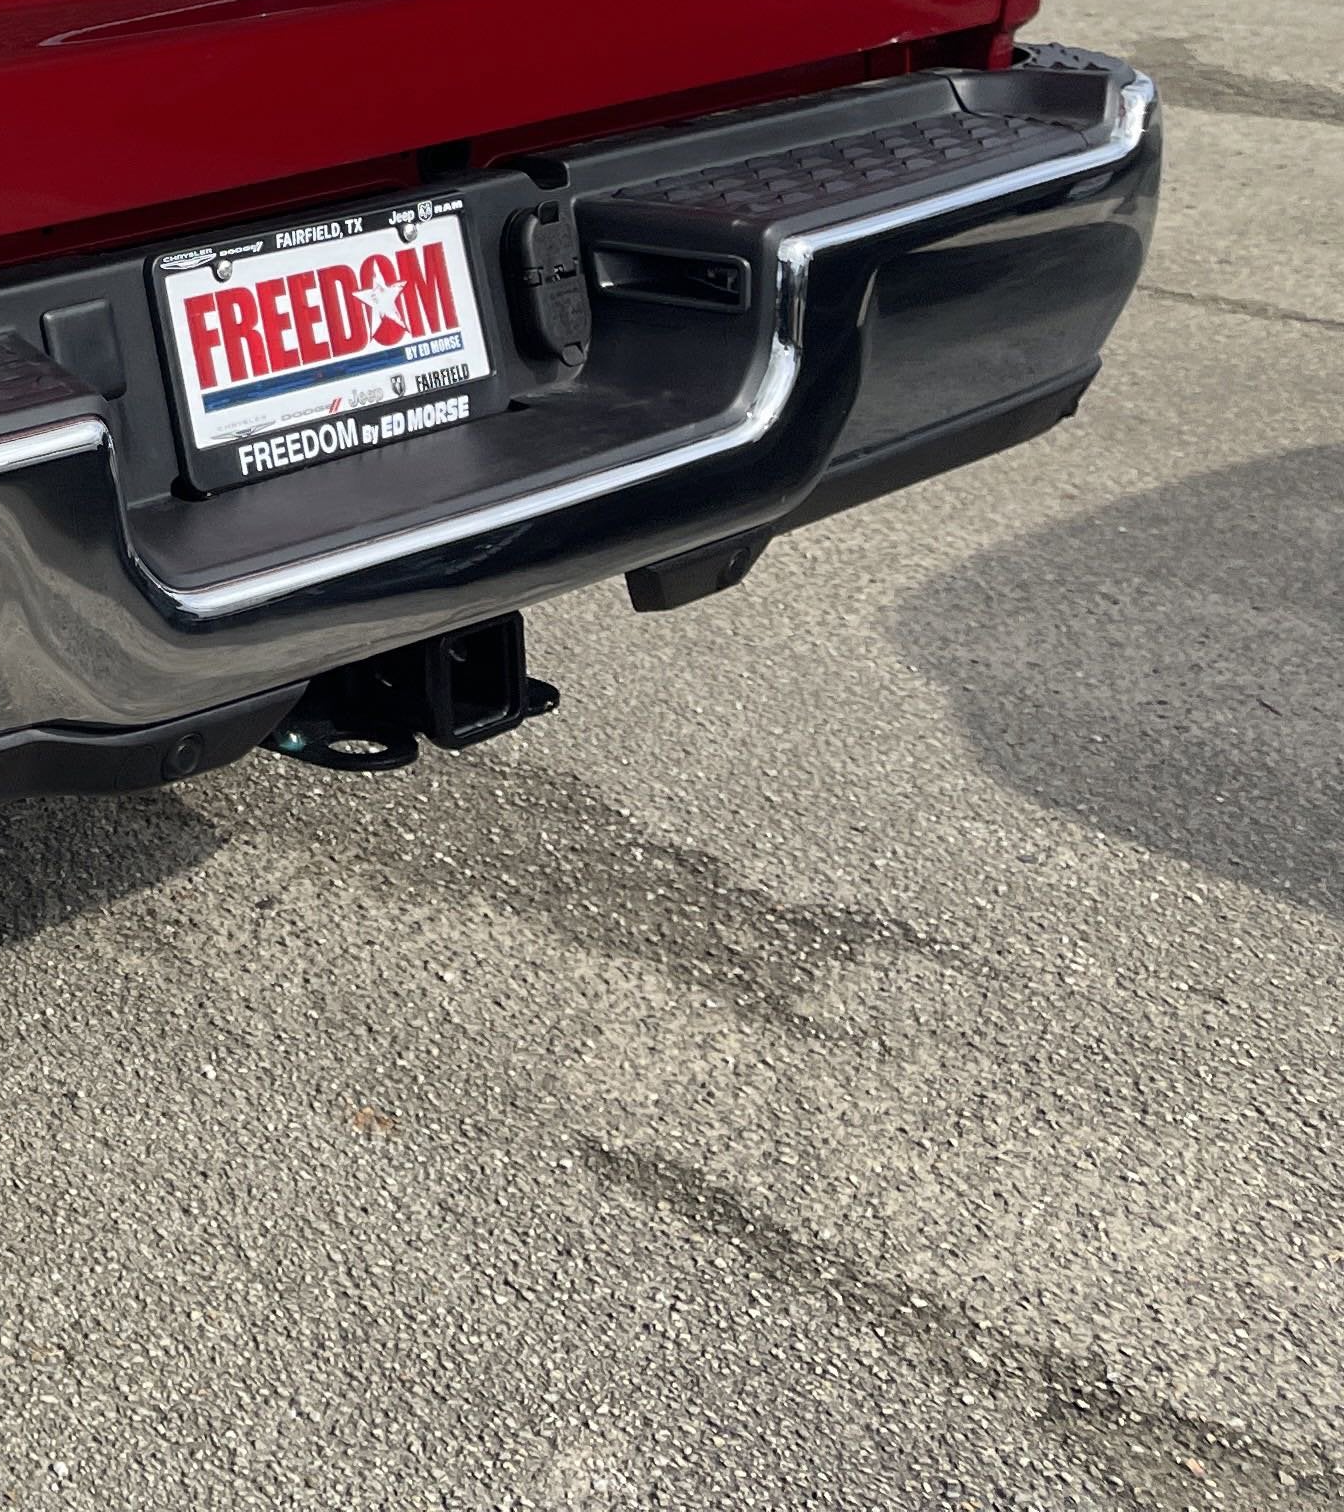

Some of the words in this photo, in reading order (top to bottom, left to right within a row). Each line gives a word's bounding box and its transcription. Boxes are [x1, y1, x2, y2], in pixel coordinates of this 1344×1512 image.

[389, 209, 415, 225] Jeep
[434, 199, 463, 214] RAM
[276, 222, 343, 248] FAIRFIELD,
[344, 217, 363, 233] TX
[163, 248, 213, 263] CHRYSLER
[184, 241, 460, 390] FREEDOM
[405, 346, 418, 361] BY
[419, 342, 431, 355] ED
[431, 335, 462, 354] MORSE
[415, 363, 470, 393] FAIRFIELD
[349, 387, 385, 408] Jeep
[238, 417, 359, 476] FREEDOM
[380, 412, 405, 439] ED
[406, 394, 470, 433] MORSE
